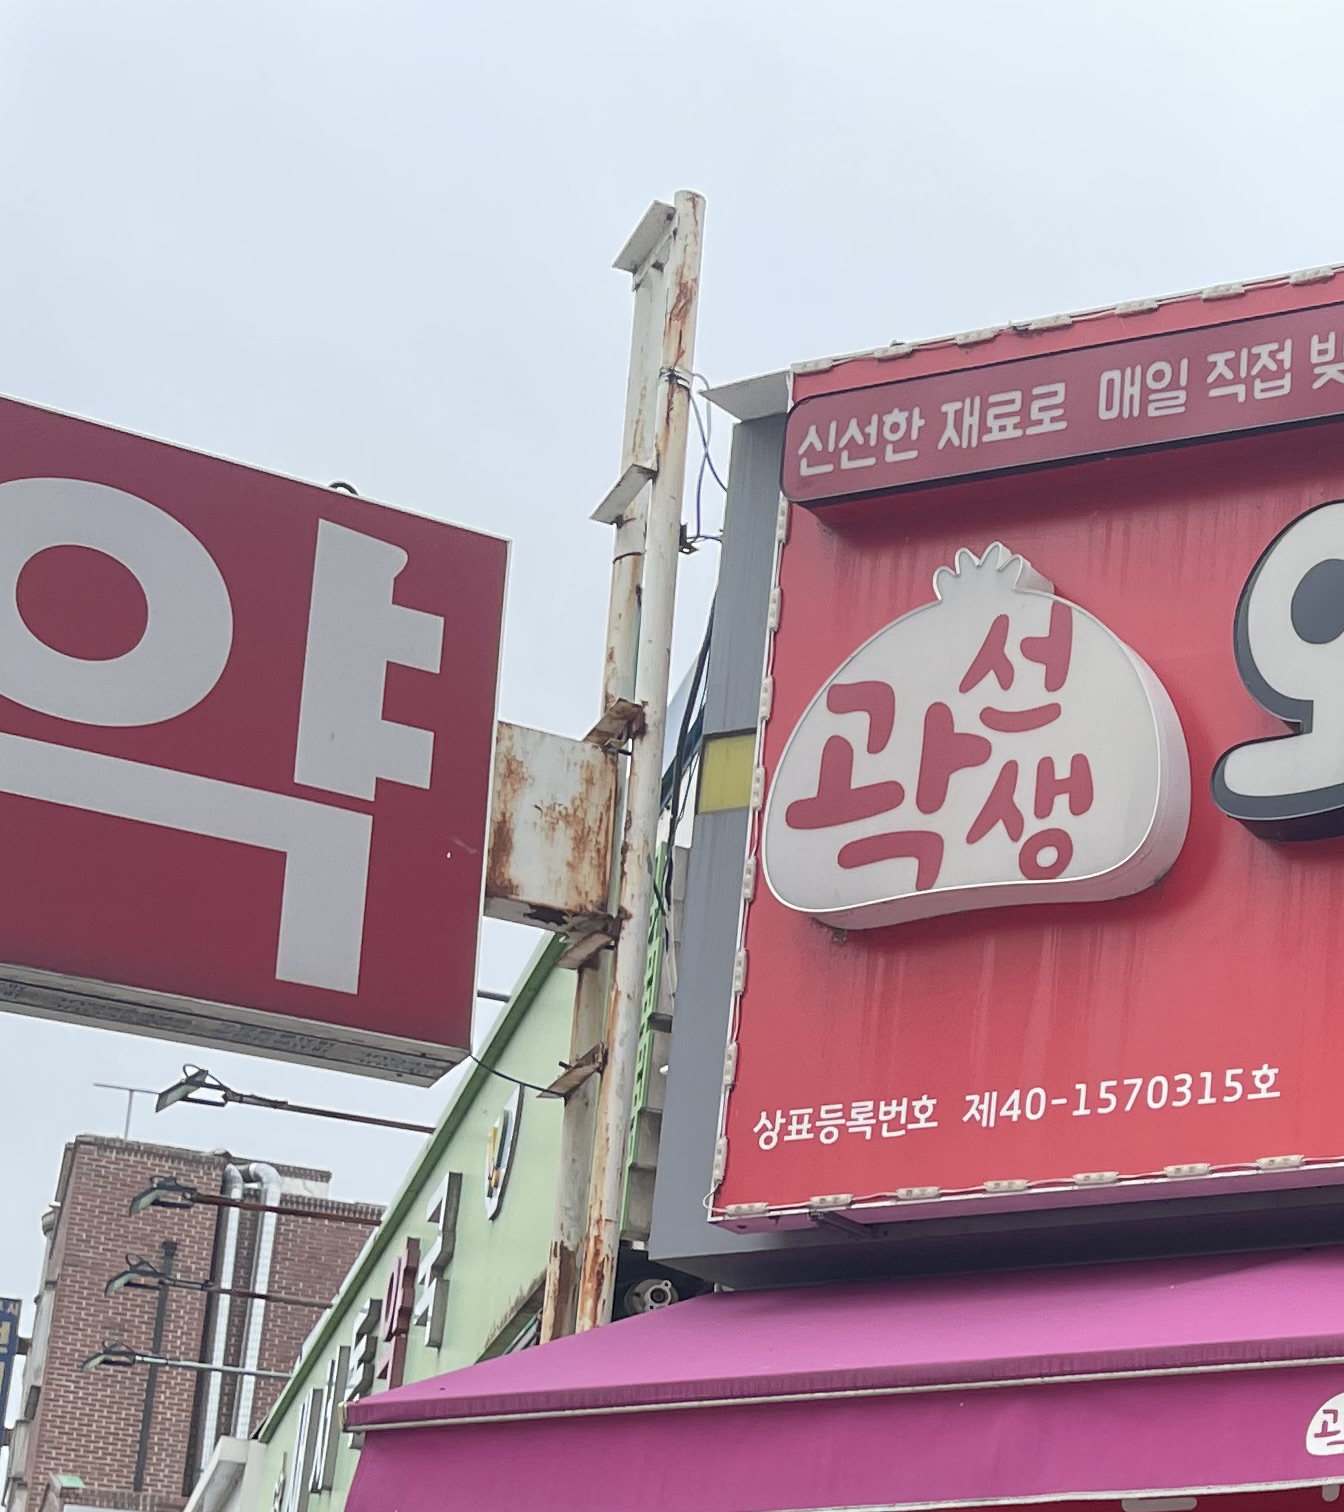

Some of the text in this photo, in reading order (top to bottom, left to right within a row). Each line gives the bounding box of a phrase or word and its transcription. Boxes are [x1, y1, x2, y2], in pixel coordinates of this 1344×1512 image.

[797, 413, 925, 476] 신선한
[937, 383, 1068, 451] 재료로
[1097, 355, 1190, 423] 매일
[1206, 340, 1294, 406] 직접
[0, 477, 445, 996] 약
[752, 1063, 1281, 1153] 상표등록번호 제40-1570315호
